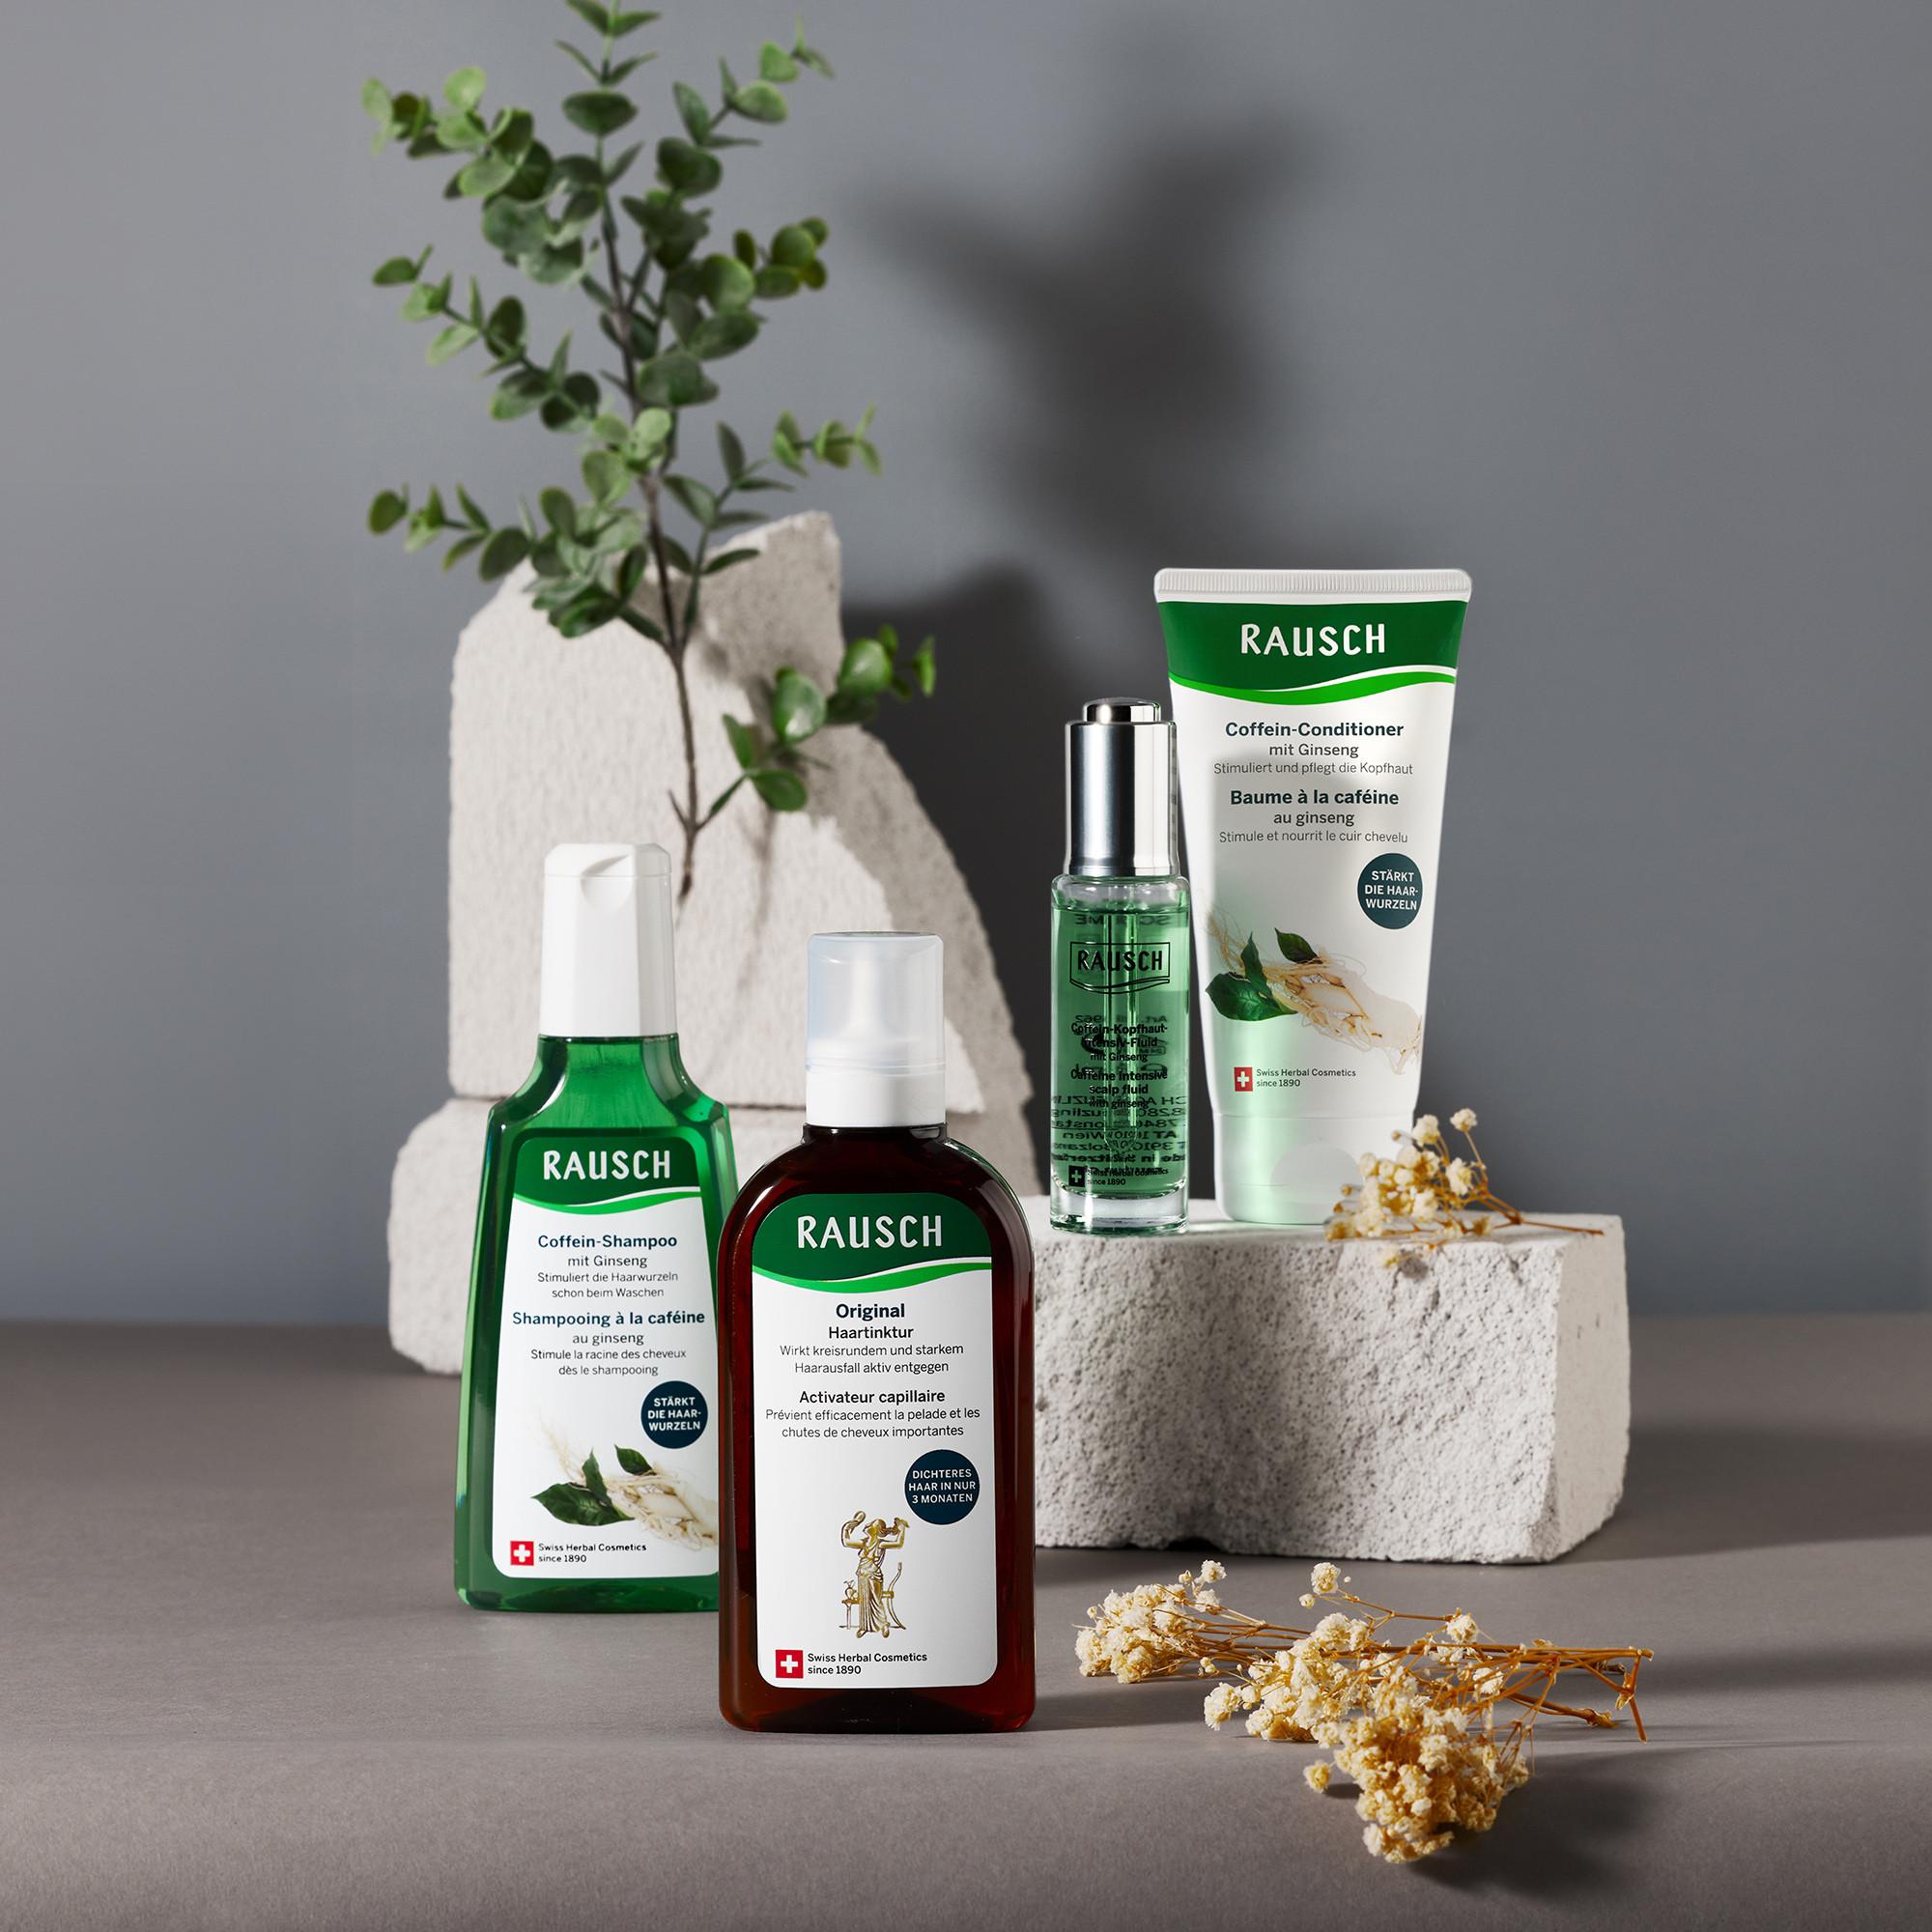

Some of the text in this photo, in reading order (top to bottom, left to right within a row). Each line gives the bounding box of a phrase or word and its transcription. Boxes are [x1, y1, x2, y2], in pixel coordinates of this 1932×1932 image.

[1240, 623, 1386, 657] RAUSCH
[1225, 722, 1404, 737] Coffein-Conditioner
[1269, 744, 1359, 758] mit Ginseng
[1214, 762, 1413, 775] Stimuliert und pflegt die Kopfhaut
[1231, 789, 1399, 805] Baume à la caféine
[1273, 811, 1355, 826] au ginseng
[1219, 831, 1408, 842] Stimule et nourrit le cuir chevelu
[1372, 869, 1414, 882] STÄRKT
[1365, 885, 1418, 896] DIE HAAR-
[1366, 898, 1417, 910] WURZELN
[1078, 950, 1163, 971] RAUSCH
[1109, 1052, 1149, 1063] Ginseng
[1312, 1068, 1356, 1077] Cosmetics
[1090, 1084, 1149, 1096] scalp fluid
[543, 1150, 670, 1180] RAUSCH
[797, 1215, 943, 1249] RAUSCH
[538, 1235, 678, 1250] Coffein-Shampoo
[568, 1255, 648, 1268] mit Ginseng
[537, 1272, 678, 1283] Stimuliert die Haarwurzeln
[552, 1288, 665, 1298] schon beim Waschen
[836, 1303, 905, 1321] Original
[512, 1310, 705, 1327] Shampooing à la caféine
[828, 1325, 914, 1339] Haartinktur
[572, 1332, 644, 1346] au ginseng
[530, 1349, 686, 1360] Stimule la racine des cheveux
[780, 1344, 964, 1356] Wirkt kreisrundem und starkem
[558, 1365, 659, 1377] dès le shampooing
[795, 1362, 949, 1376] Haarausfall aktiv entgegen
[653, 1396, 696, 1407] STÄRKT
[799, 1389, 946, 1406] Activateur capillaire
[647, 1408, 701, 1419] DIE HAAR-
[766, 1407, 980, 1422] Prévient efficacement la pelade et les
[648, 1421, 701, 1432] WURZELN
[781, 1426, 964, 1440] chutes de cheveux importantes
[912, 1468, 972, 1479] DICHTERES
[908, 1480, 976, 1492] HAAR IN NUR
[912, 1493, 973, 1504] 3 MONATEN
[538, 1543, 647, 1551] Swiss Herbal Cosmetics
[538, 1554, 587, 1563] since 1890
[808, 1652, 927, 1662] Swiss Herbal Cosmetics
[808, 1665, 862, 1675] since 1890
